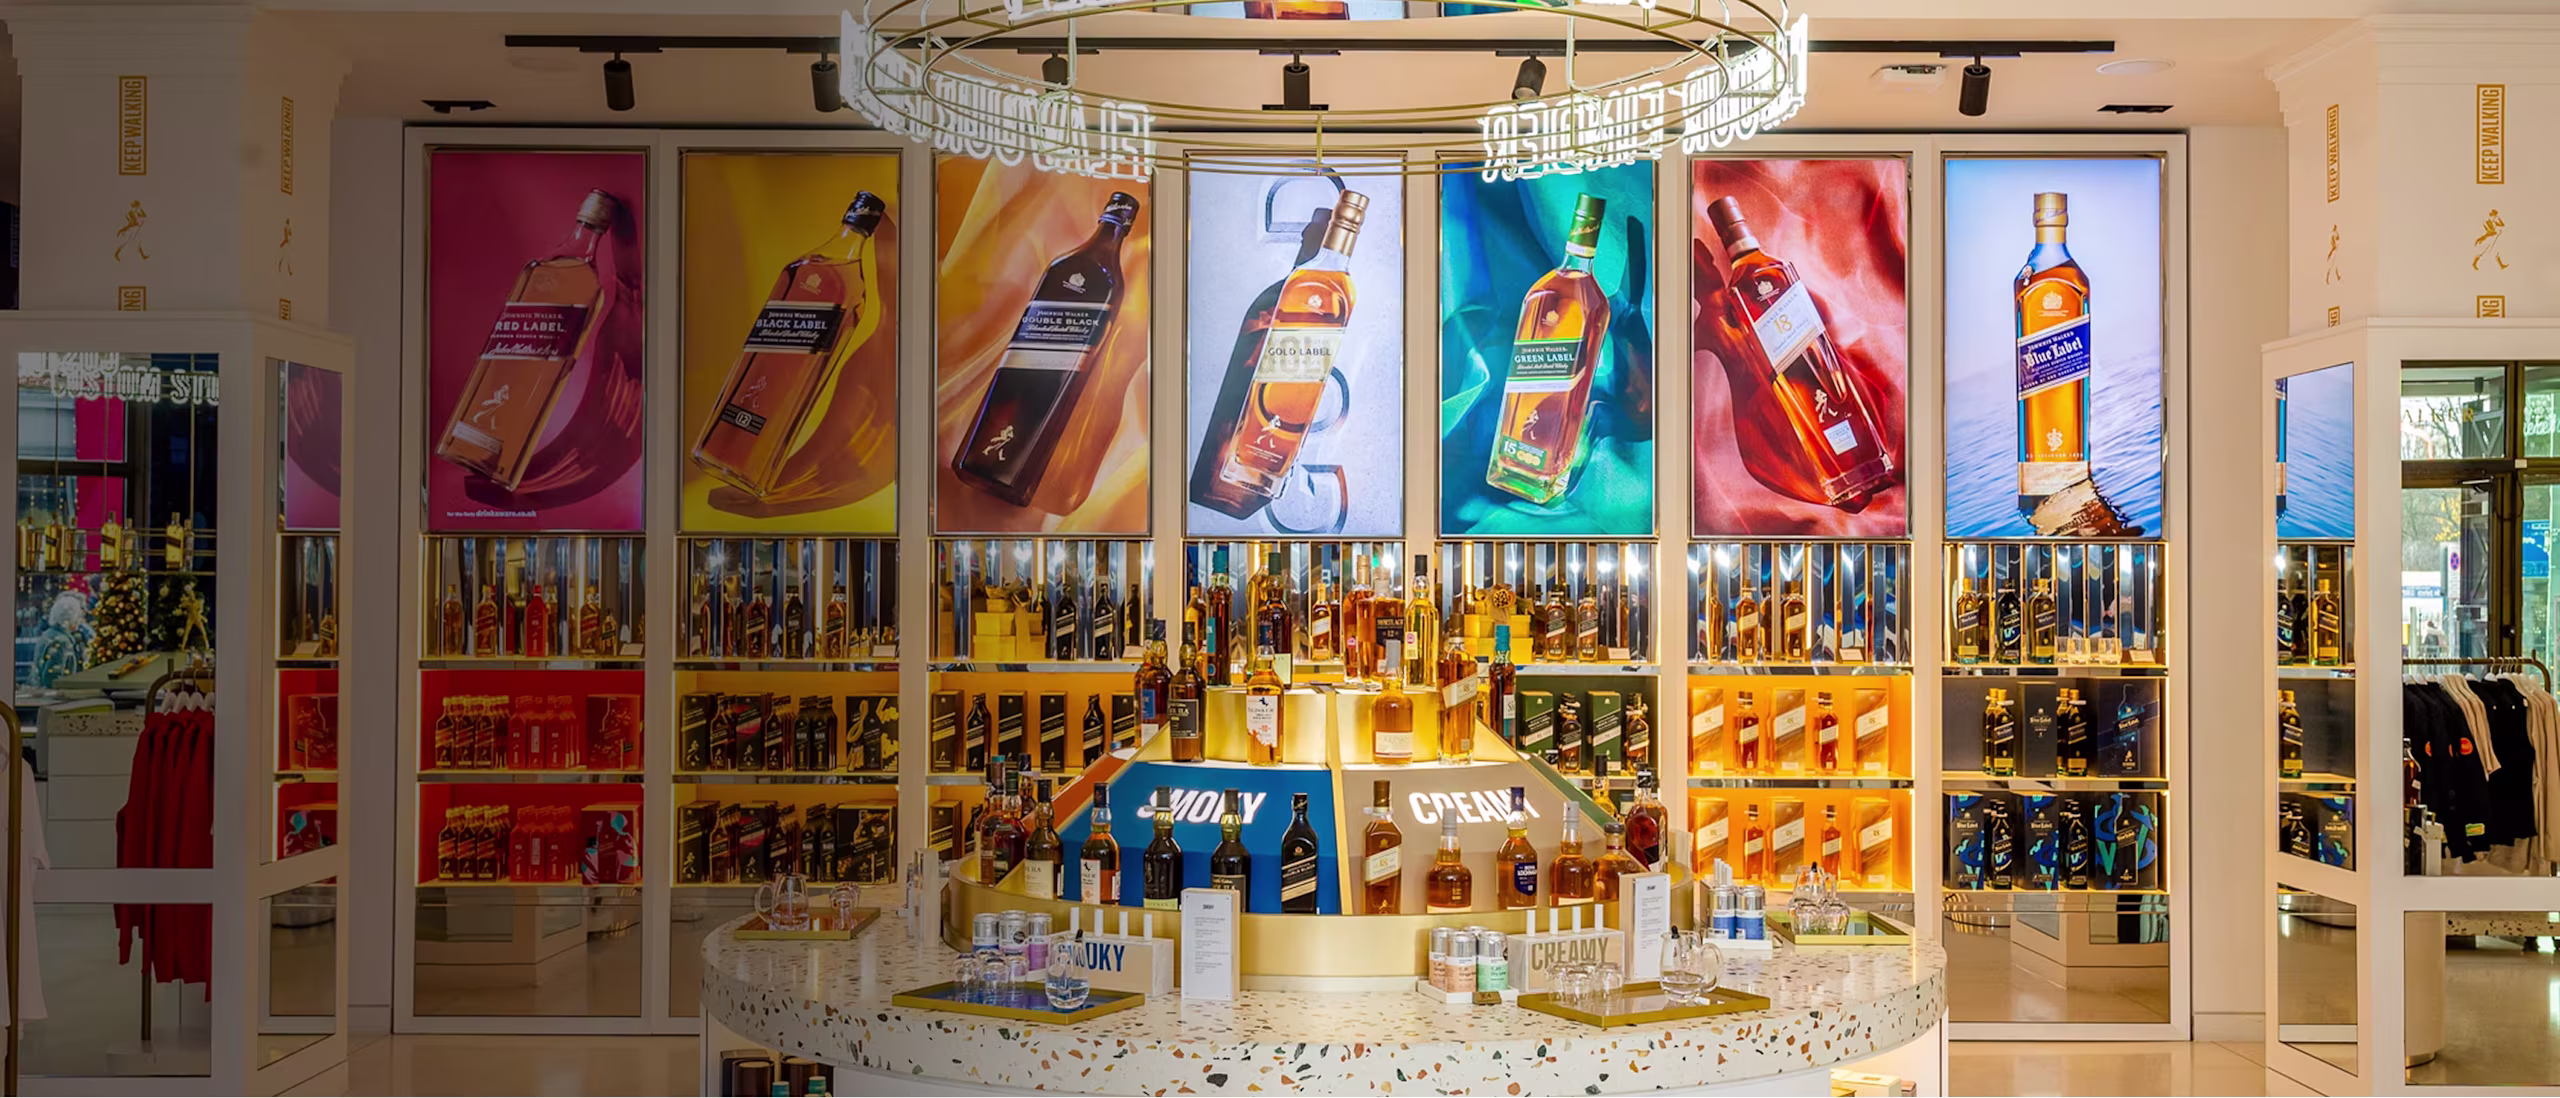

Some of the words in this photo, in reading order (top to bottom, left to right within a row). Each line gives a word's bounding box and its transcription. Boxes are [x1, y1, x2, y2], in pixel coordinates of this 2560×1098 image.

[123, 80, 142, 138] WALKING
[2481, 89, 2500, 147] WALKING
[283, 101, 292, 158] WALKING
[2329, 109, 2338, 165] WALKING
[123, 140, 142, 172] KEEP
[2481, 150, 2500, 179] KEEP
[283, 158, 291, 190] KEEP
[2329, 165, 2338, 197] KEEP
[495, 321, 520, 331] RED
[523, 321, 564, 332] LABEL
[756, 318, 791, 328] BLACK
[794, 319, 828, 330] LABEL
[1022, 316, 1062, 325] DOUBLE
[1065, 317, 1099, 326] BLACK
[1773, 313, 1793, 334] 18
[1268, 347, 1296, 356] GOLD
[1299, 347, 1331, 356] LABEL
[1514, 354, 1545, 363] GREEN
[1546, 353, 1575, 362] LABEL
[2022, 350, 2053, 369] Blue
[2049, 336, 2083, 359] Label
[1503, 440, 1517, 455] 15
[1531, 937, 1608, 970] CREAMY
